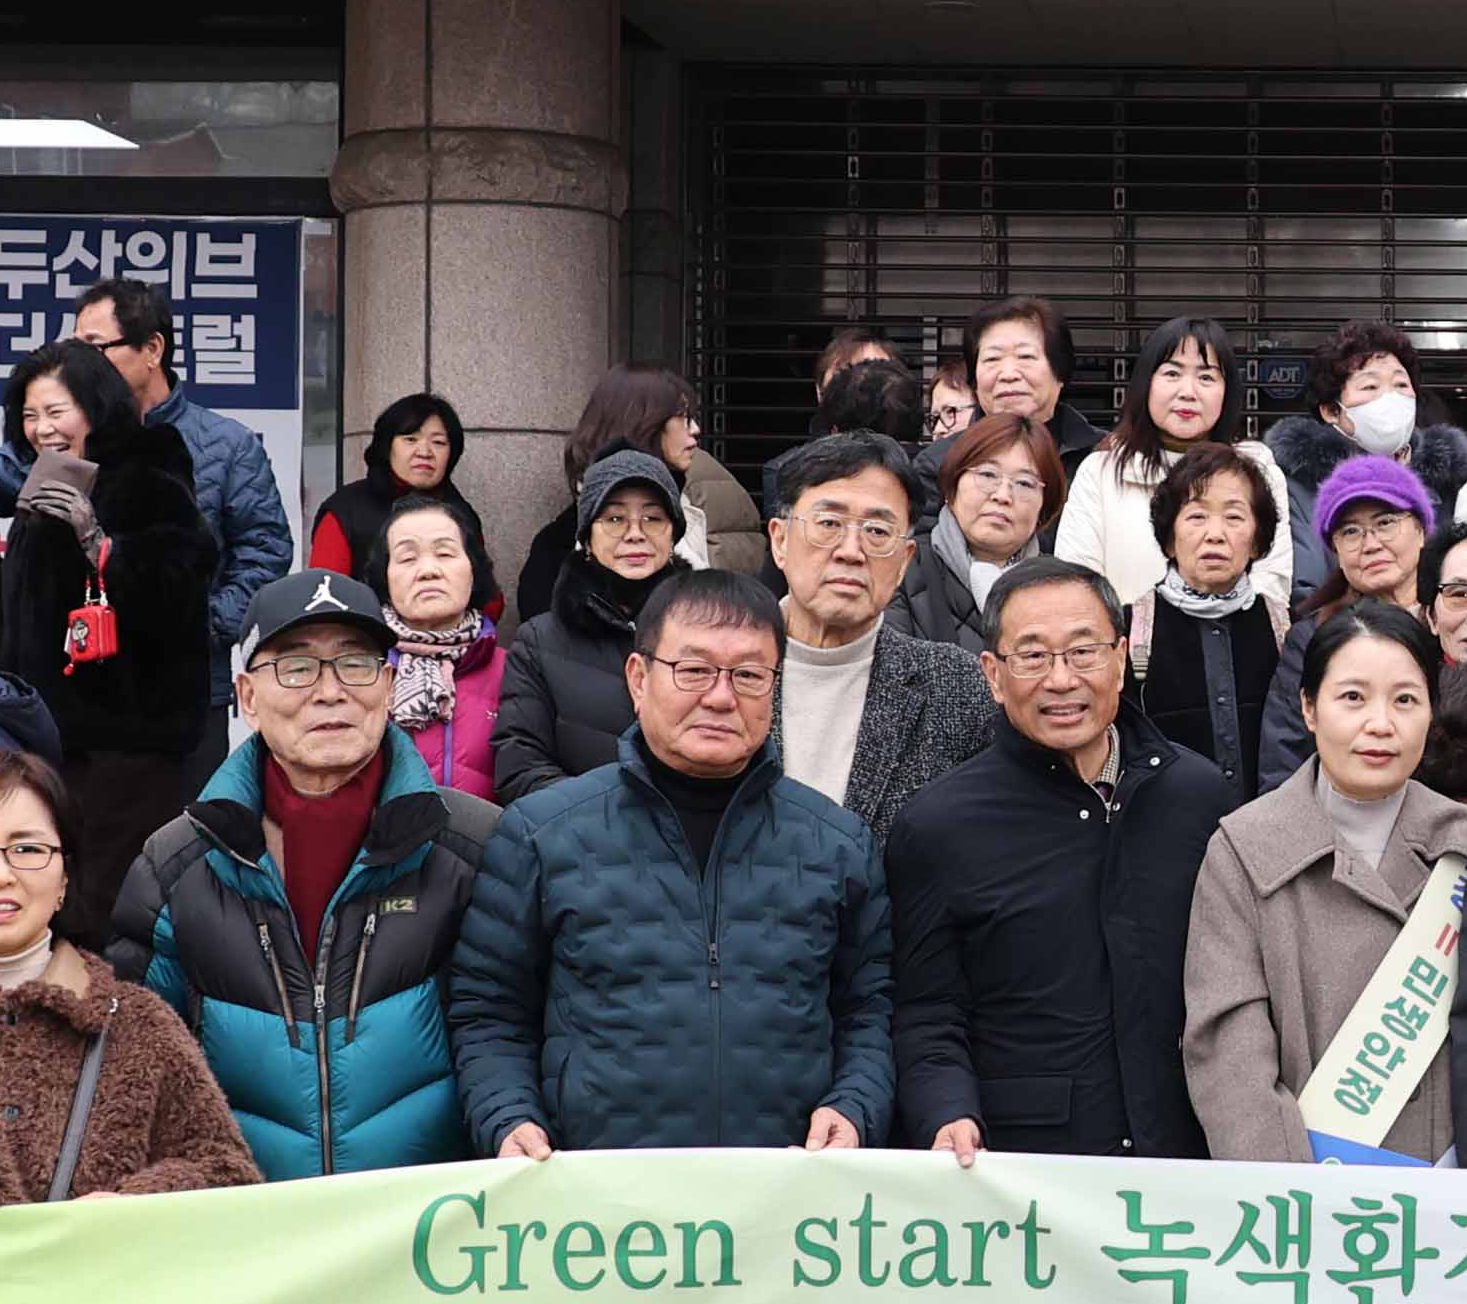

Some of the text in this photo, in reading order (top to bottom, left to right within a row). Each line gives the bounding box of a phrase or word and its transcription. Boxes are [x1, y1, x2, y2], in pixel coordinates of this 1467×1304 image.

[1332, 955, 1449, 1116] 민생안정
[412, 1191, 741, 1297] Green
[792, 1191, 1057, 1291] start
